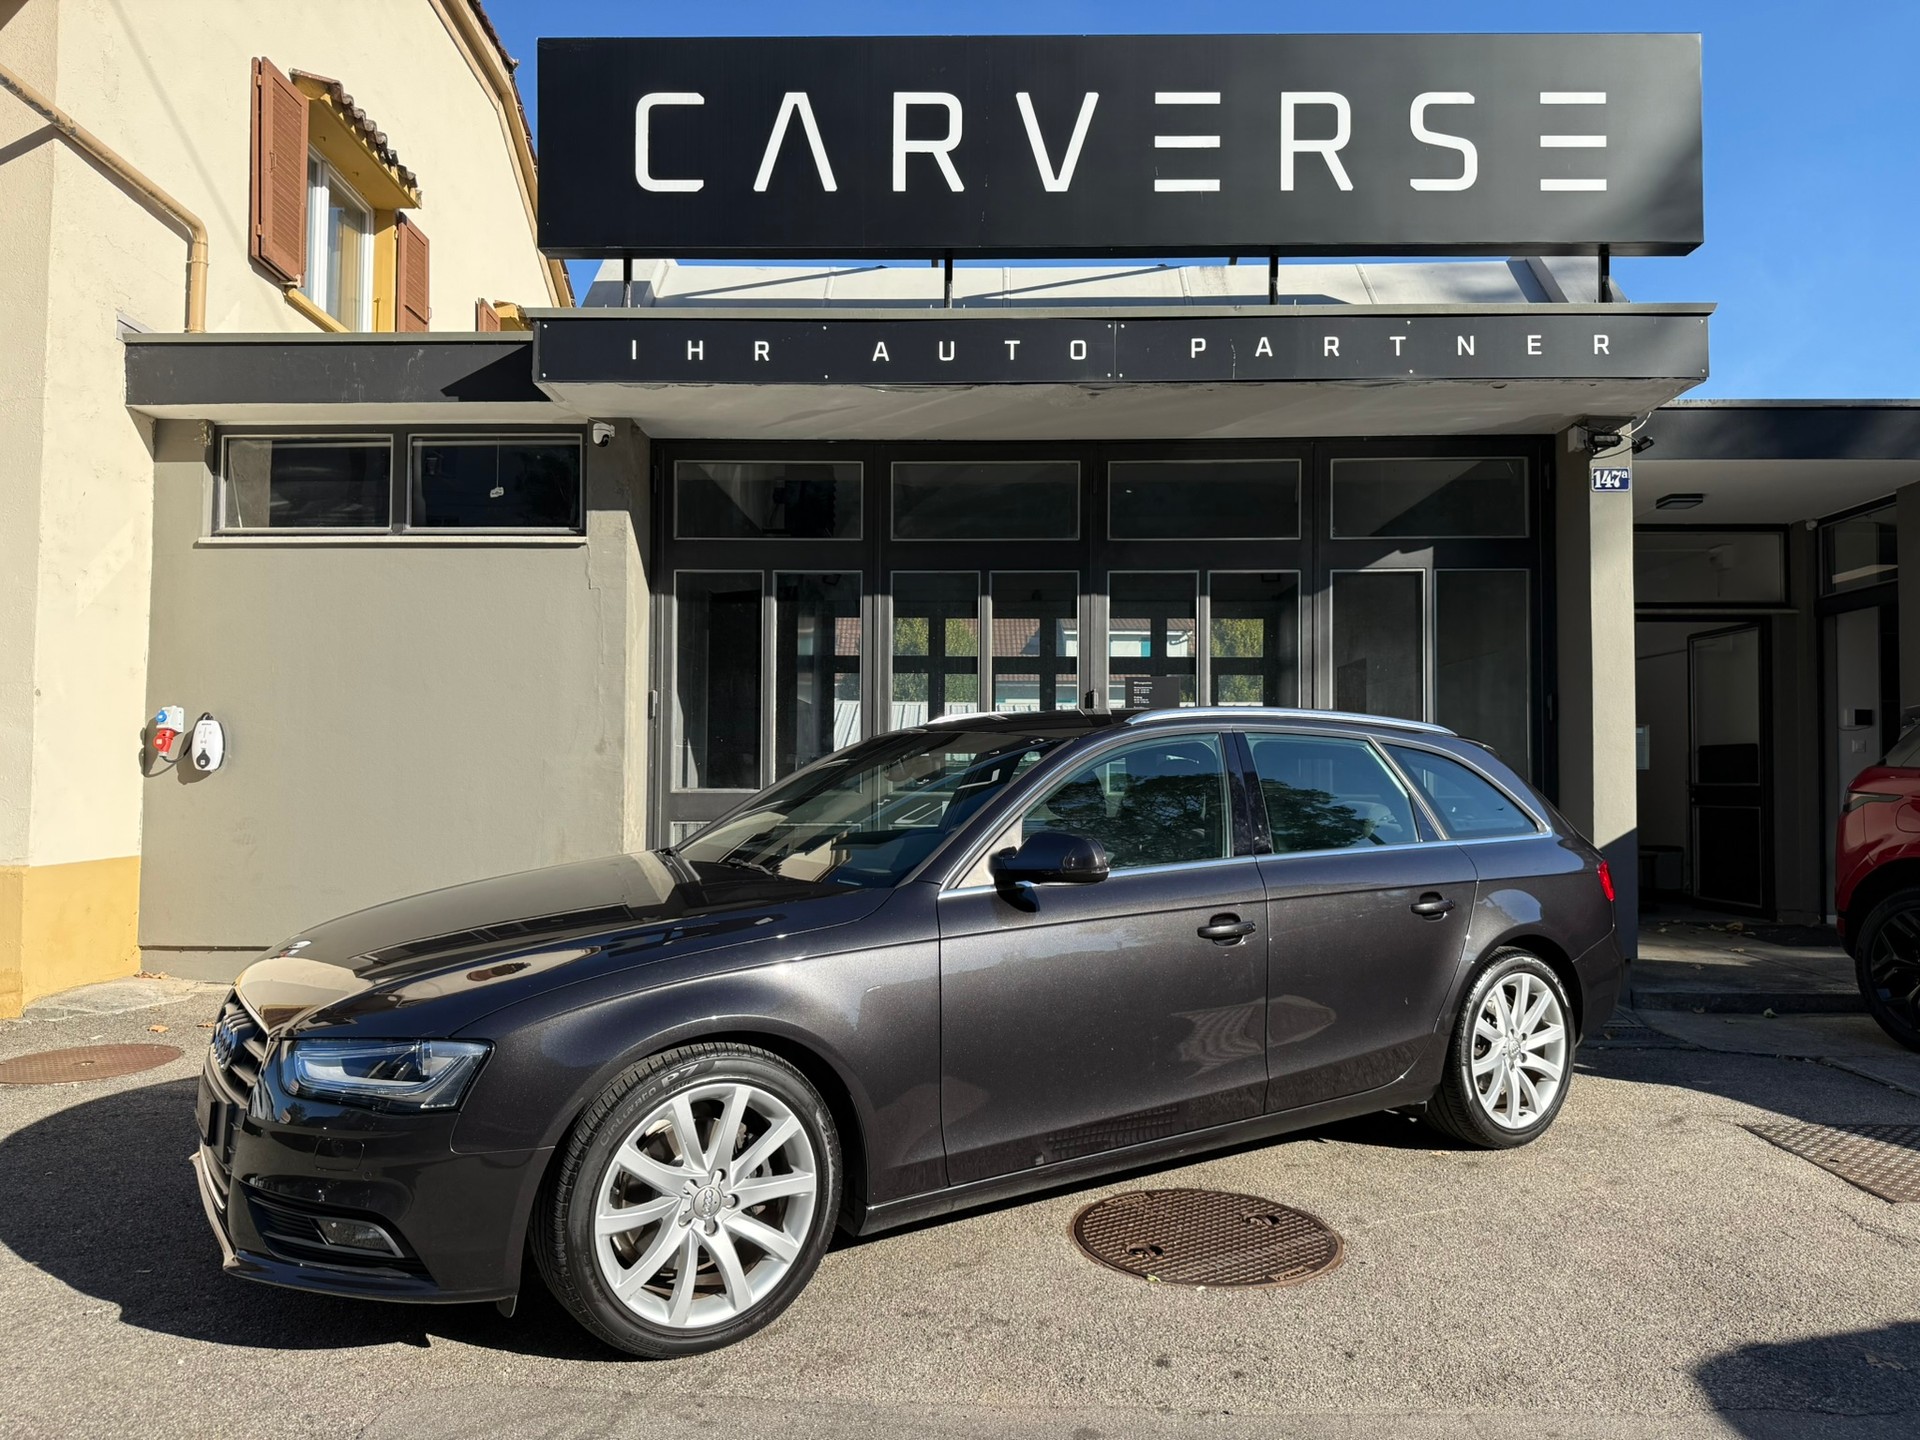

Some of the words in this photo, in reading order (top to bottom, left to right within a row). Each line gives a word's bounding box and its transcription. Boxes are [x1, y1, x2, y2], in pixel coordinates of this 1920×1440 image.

[636, 92, 1607, 193] CARVERSE
[631, 339, 770, 362] IHR
[872, 339, 1087, 362] AUTO
[1190, 335, 1610, 359] PARTNER
[1593, 470, 1628, 488] 147a
[661, 1064, 699, 1087] P7
